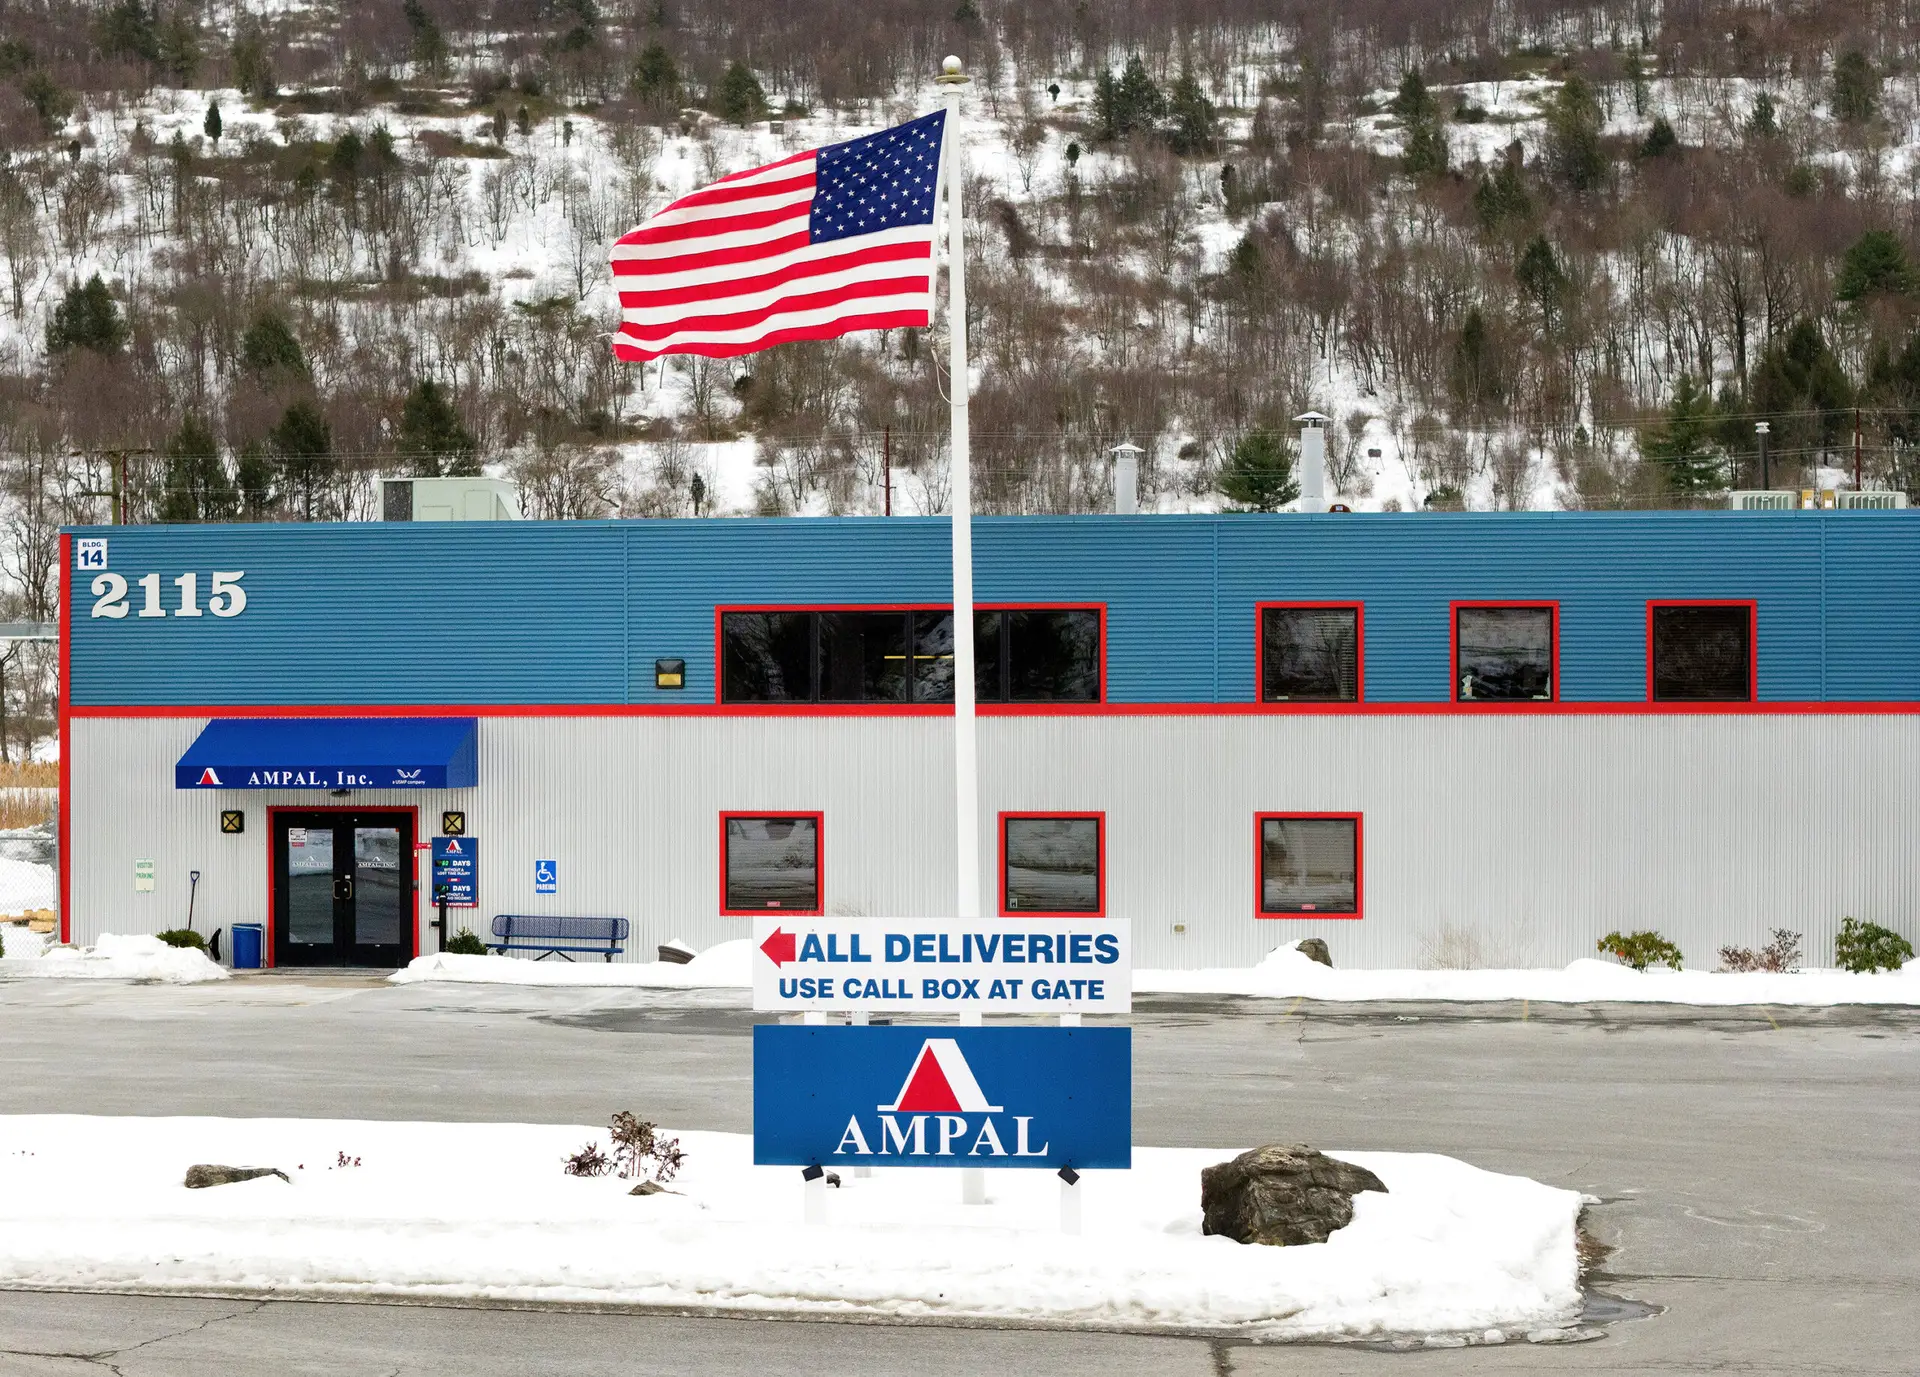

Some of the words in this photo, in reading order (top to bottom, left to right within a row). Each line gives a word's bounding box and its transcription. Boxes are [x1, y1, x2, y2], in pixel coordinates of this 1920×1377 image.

[80, 550, 104, 567] 14
[91, 570, 247, 619] 2115
[248, 771, 328, 788] AMPAL,
[337, 771, 373, 785] Inc.
[799, 933, 872, 963] ALL
[886, 933, 1119, 964] DELIVERIES
[779, 978, 834, 999] USE
[843, 978, 913, 999] CALL
[922, 979, 979, 1000] BOX
[988, 979, 1023, 1000] AT
[1032, 979, 1104, 1000] GATE
[833, 1114, 1049, 1157] AMPAL
